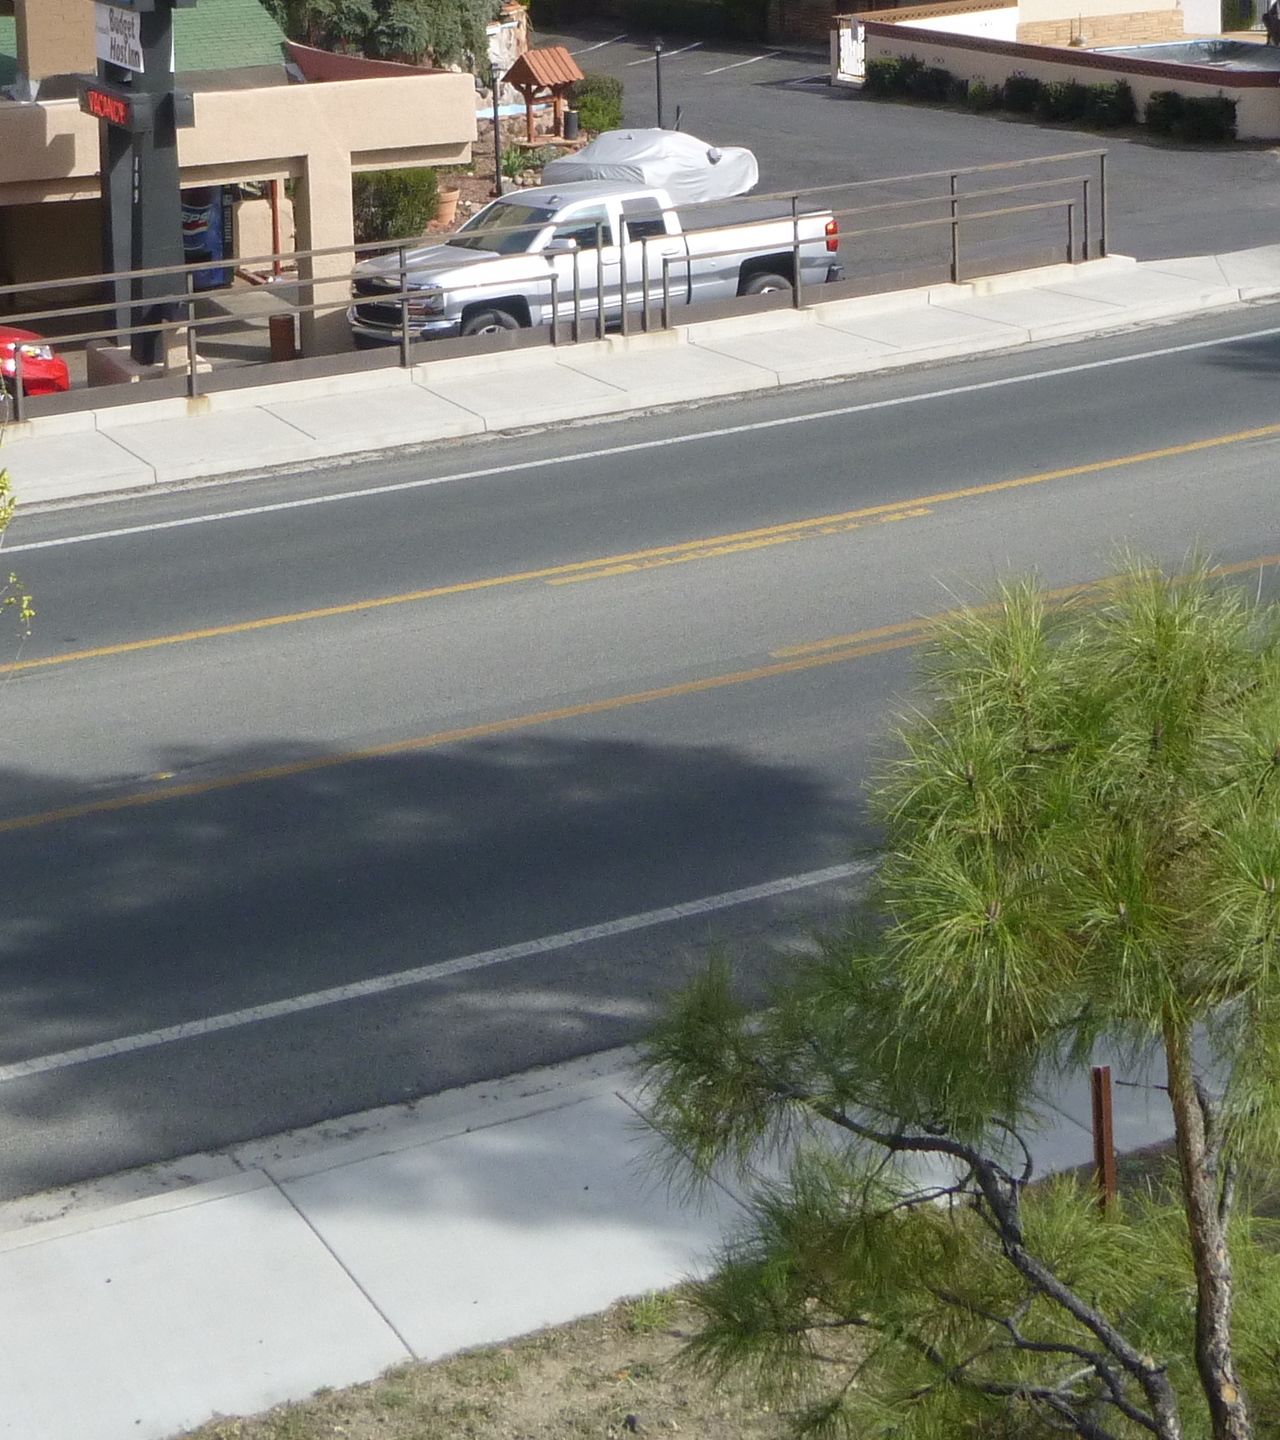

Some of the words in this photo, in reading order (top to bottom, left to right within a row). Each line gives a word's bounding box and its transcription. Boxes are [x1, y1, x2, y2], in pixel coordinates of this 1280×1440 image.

[109, 8, 135, 45] Budget
[110, 37, 128, 65] Host
[128, 43, 140, 68] Inn
